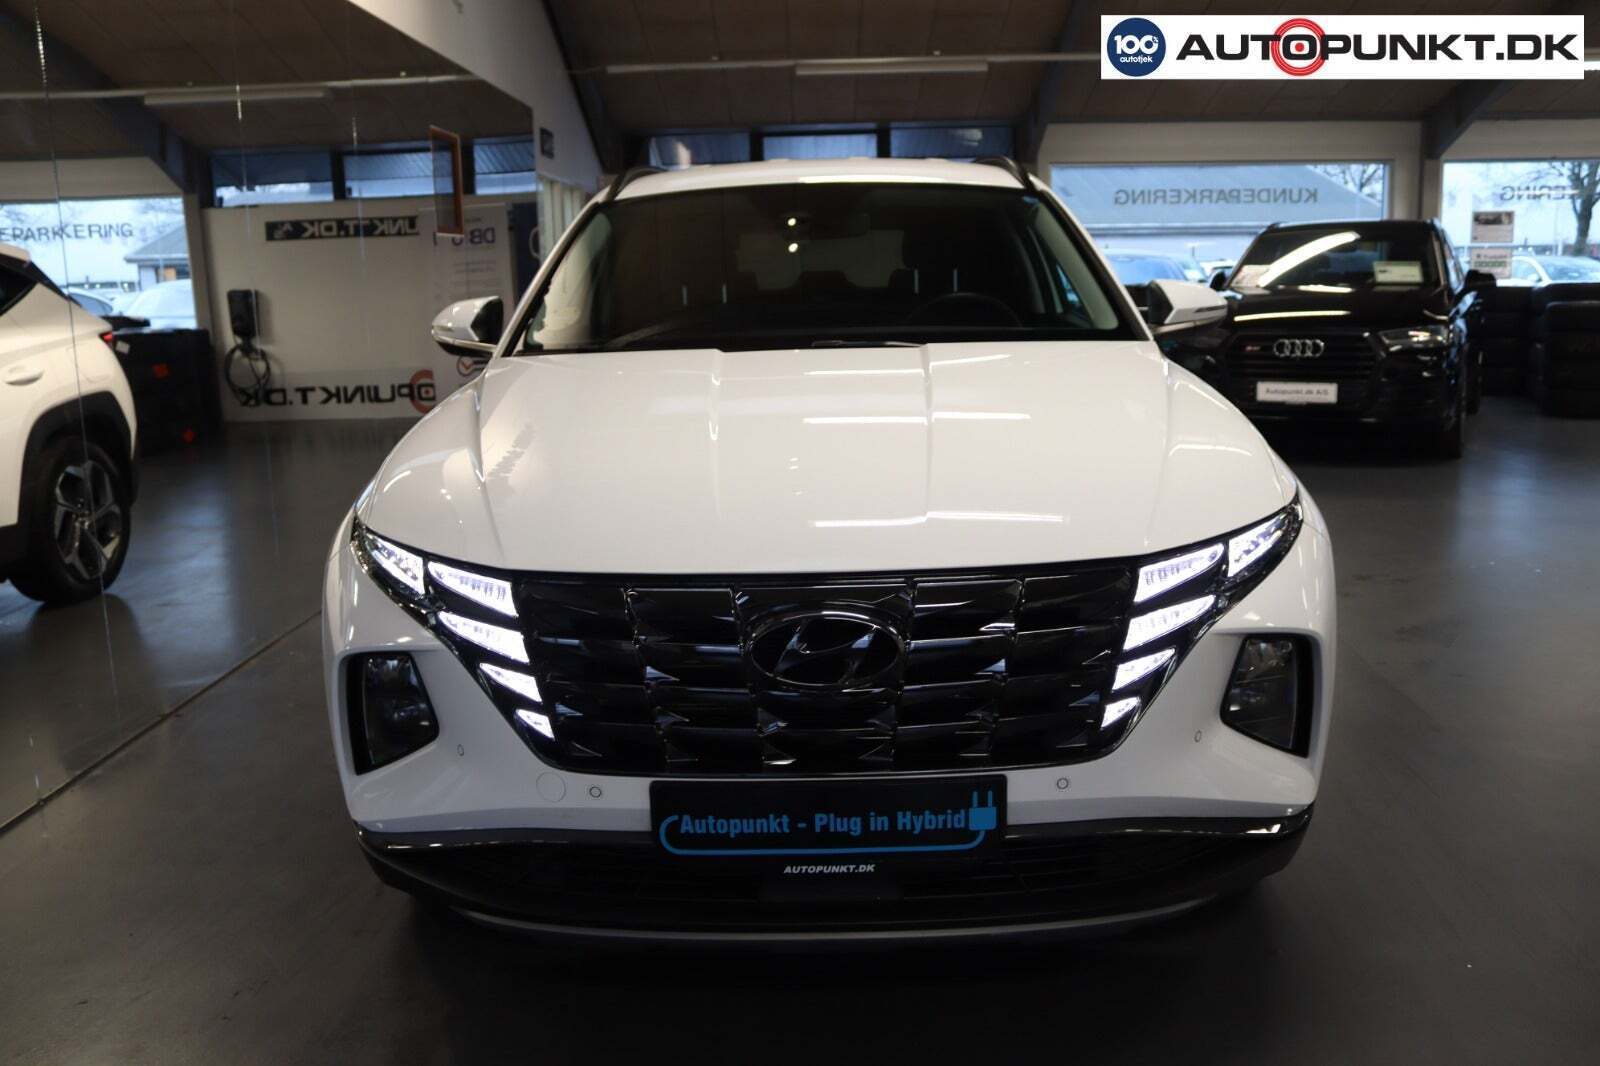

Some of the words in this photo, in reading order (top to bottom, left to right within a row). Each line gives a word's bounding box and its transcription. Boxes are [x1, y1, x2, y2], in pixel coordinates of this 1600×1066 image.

[680, 812, 791, 839] Autopunkt
[814, 811, 862, 836] Plug
[869, 810, 890, 832] in
[897, 808, 966, 835] Hybrid
[783, 863, 876, 875] AUTOPUNKT.DK
